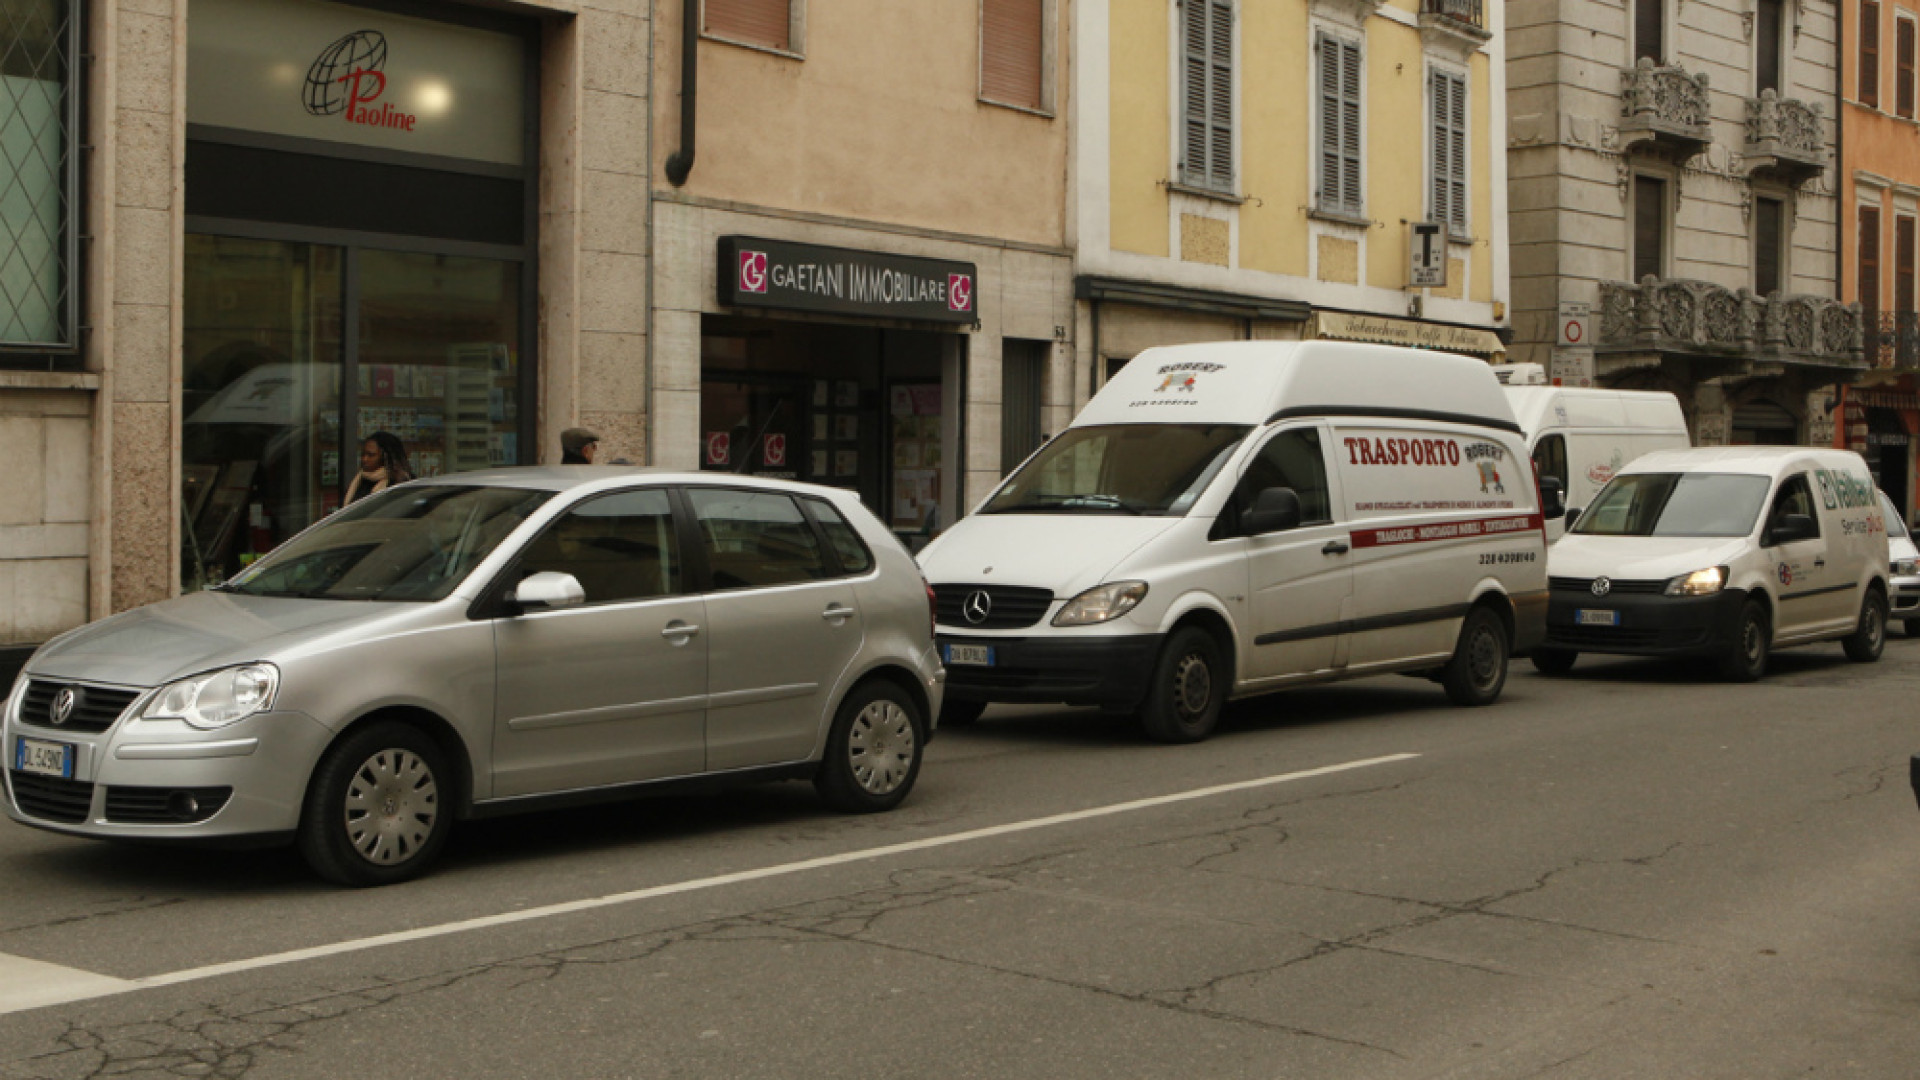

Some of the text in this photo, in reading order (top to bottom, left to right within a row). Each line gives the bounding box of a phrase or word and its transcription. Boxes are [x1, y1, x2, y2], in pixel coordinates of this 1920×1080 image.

[337, 65, 416, 132] Paoline
[1415, 225, 1439, 267] T
[771, 262, 945, 304] GAETANI IMMOBILIARE
[1344, 437, 1460, 466] TRASPORTO
[1464, 443, 1504, 462] ROBERT
